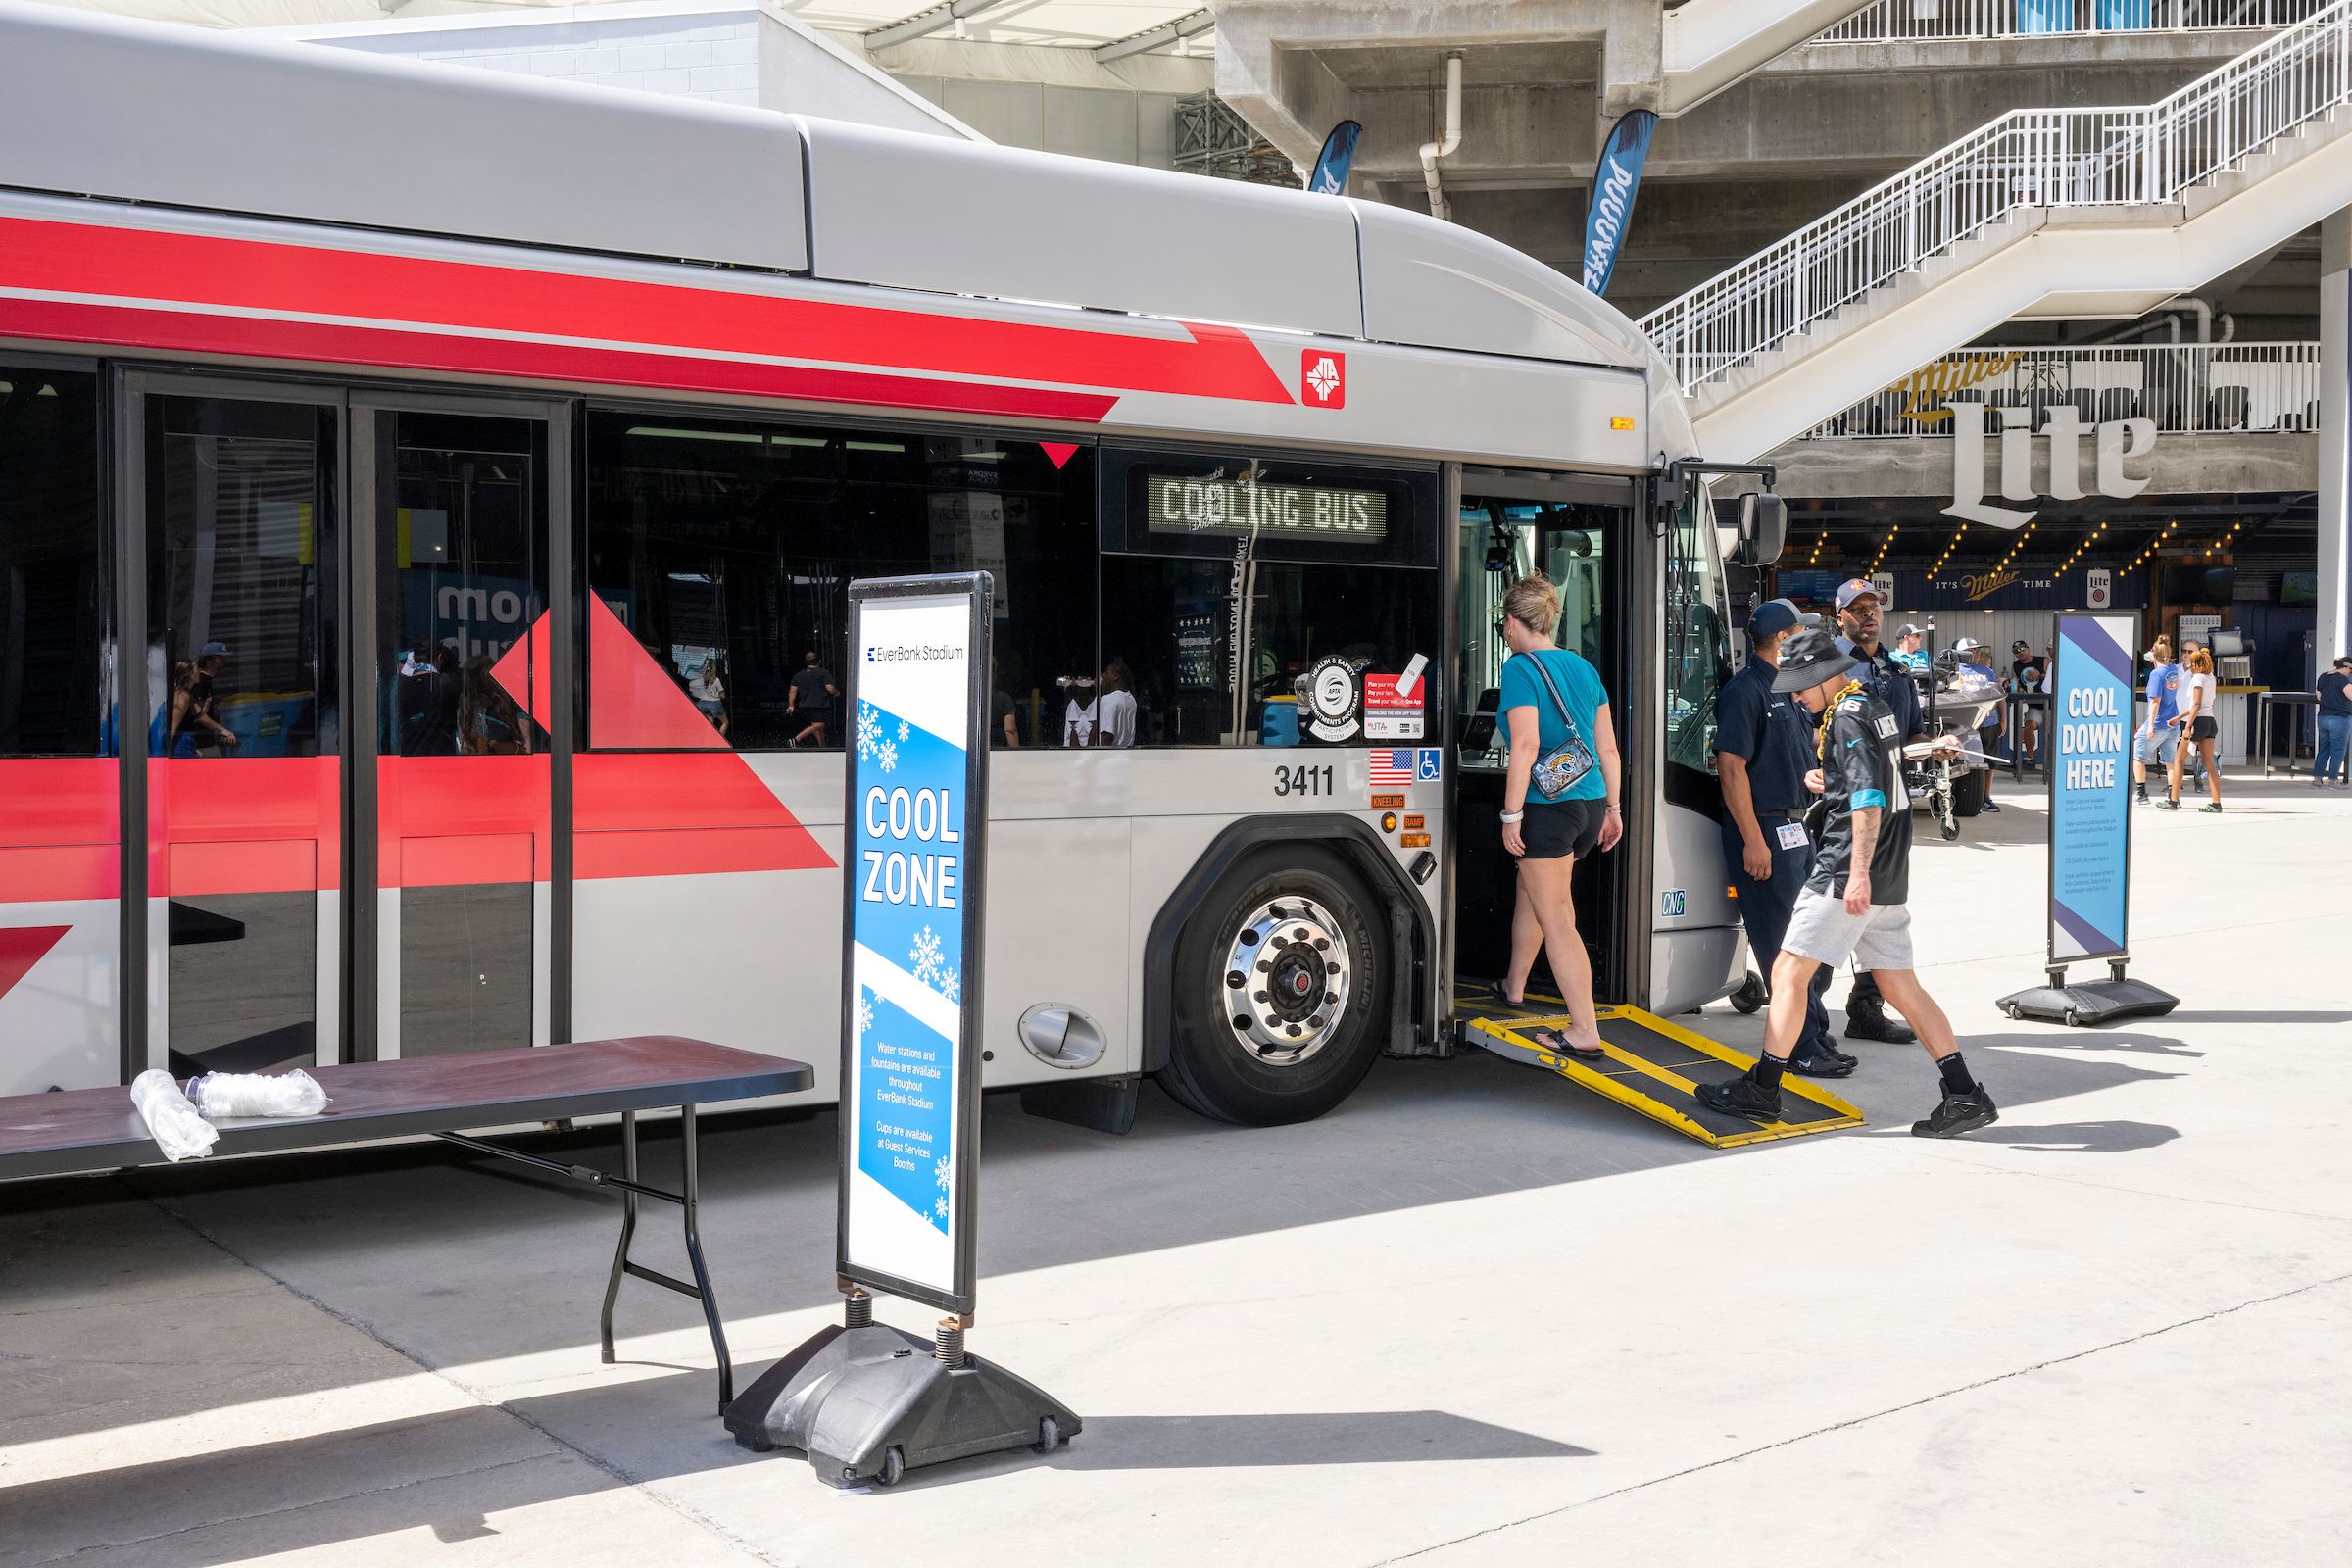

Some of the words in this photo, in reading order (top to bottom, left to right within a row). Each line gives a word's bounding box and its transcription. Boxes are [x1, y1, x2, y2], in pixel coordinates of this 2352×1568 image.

[1886, 351, 2026, 414] Miller
[1940, 402, 2157, 529] Lite
[1163, 482, 1299, 527] COOLING
[1315, 493, 1369, 530] BUS
[1936, 580, 1958, 589] IT'S
[1960, 570, 2021, 599] Miller
[2089, 577, 2109, 588] Lite
[877, 645, 921, 662] EverBank
[923, 645, 963, 661] Stadium
[1311, 658, 1331, 678] HEALTH
[1338, 658, 1356, 677] SAFETY
[1308, 691, 1342, 725] COMMITMENTS
[1342, 690, 1359, 723] PROGRAM
[2068, 687, 2119, 718] COOL
[1315, 721, 1353, 734] PARTICIPATING
[2062, 723, 2122, 756] DOWN
[1274, 765, 1333, 796] 3411
[2066, 759, 2117, 790] HERE
[1373, 796, 1403, 807] KNEELING
[865, 785, 959, 843] COOL
[1405, 817, 1424, 827] RAMP
[863, 849, 957, 909] ZONE
[1663, 892, 1684, 915] CNG
[1358, 928, 1373, 1008] MICHELIN
[877, 1041, 897, 1054] Water
[897, 1046, 922, 1059] stations
[922, 1051, 935, 1061] and
[871, 1056, 901, 1071] fountains
[901, 1063, 911, 1073] are
[912, 1065, 941, 1079] available
[888, 1076, 923, 1092] throughout
[877, 1089, 906, 1104] EverBank
[907, 1094, 934, 1110] Stadium
[876, 1120, 893, 1135] Cups
[893, 1125, 904, 1136] are
[905, 1127, 933, 1143] available
[877, 1138, 884, 1148] at
[884, 1138, 903, 1153] Guest
[904, 1143, 931, 1158] Services
[893, 1155, 915, 1171] Booths
